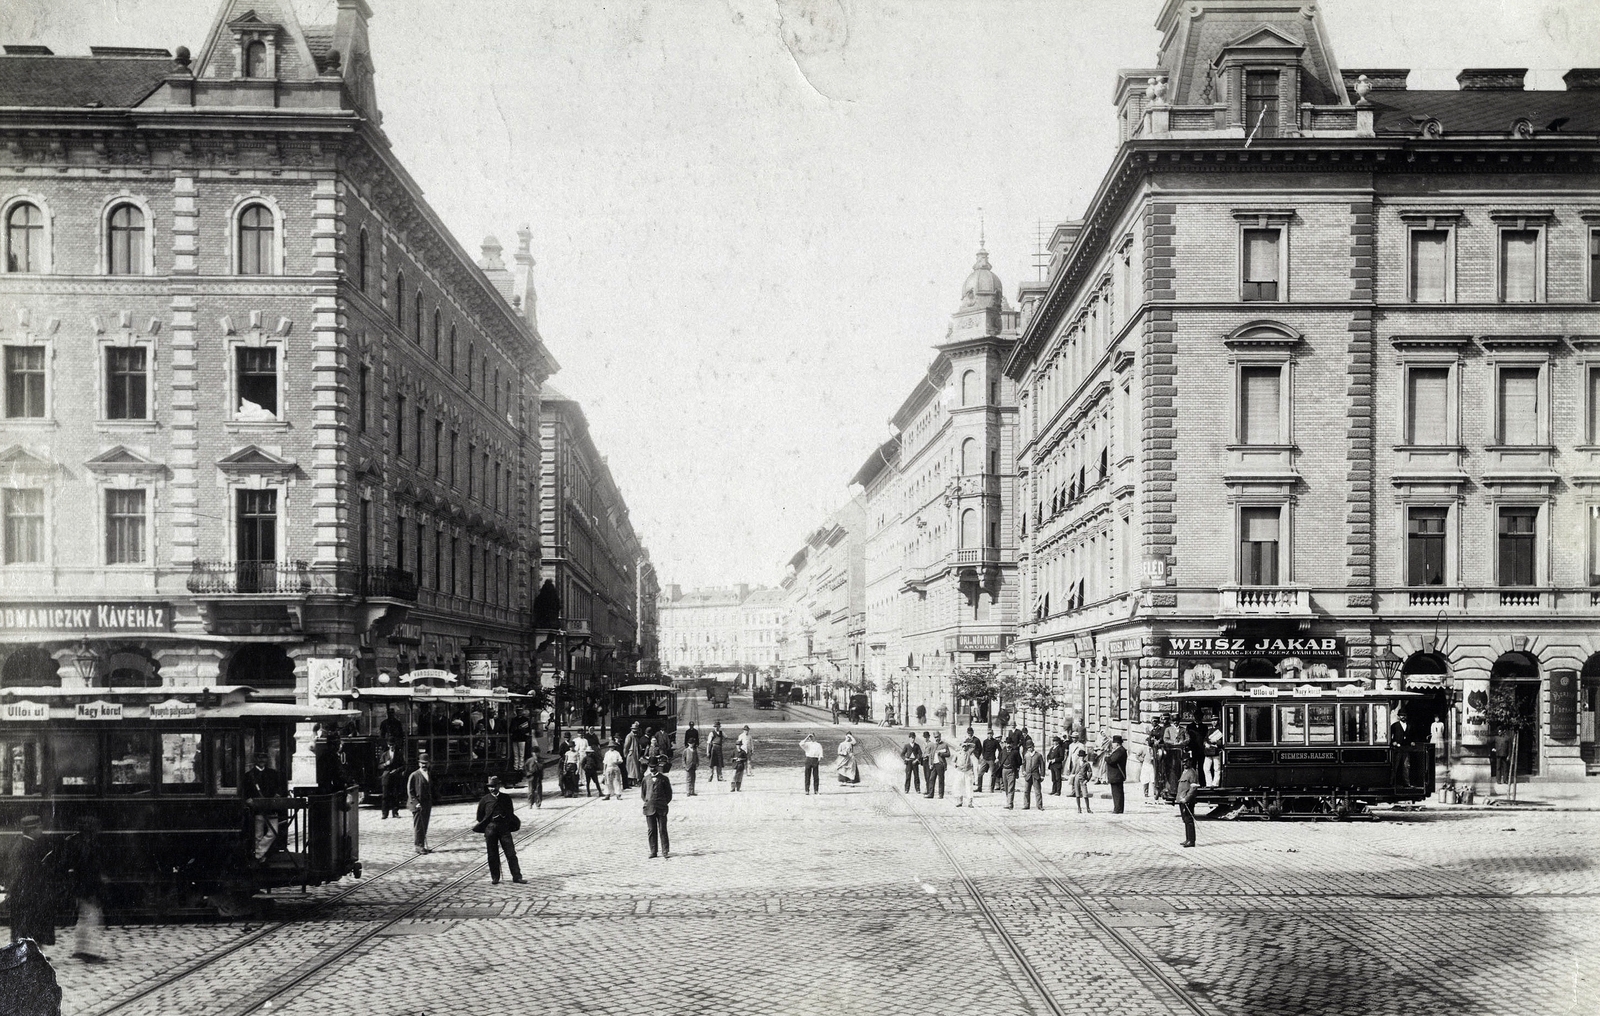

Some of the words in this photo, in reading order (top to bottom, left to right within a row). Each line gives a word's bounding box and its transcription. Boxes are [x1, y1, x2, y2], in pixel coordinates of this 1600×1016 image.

[97, 604, 164, 628] KÁVÉHÁZ
[1168, 638, 1245, 650] WEISZ
[1254, 638, 1337, 650] JAKAB
[78, 705, 98, 718] Nagy
[1280, 752, 1309, 760] SIEMENS
